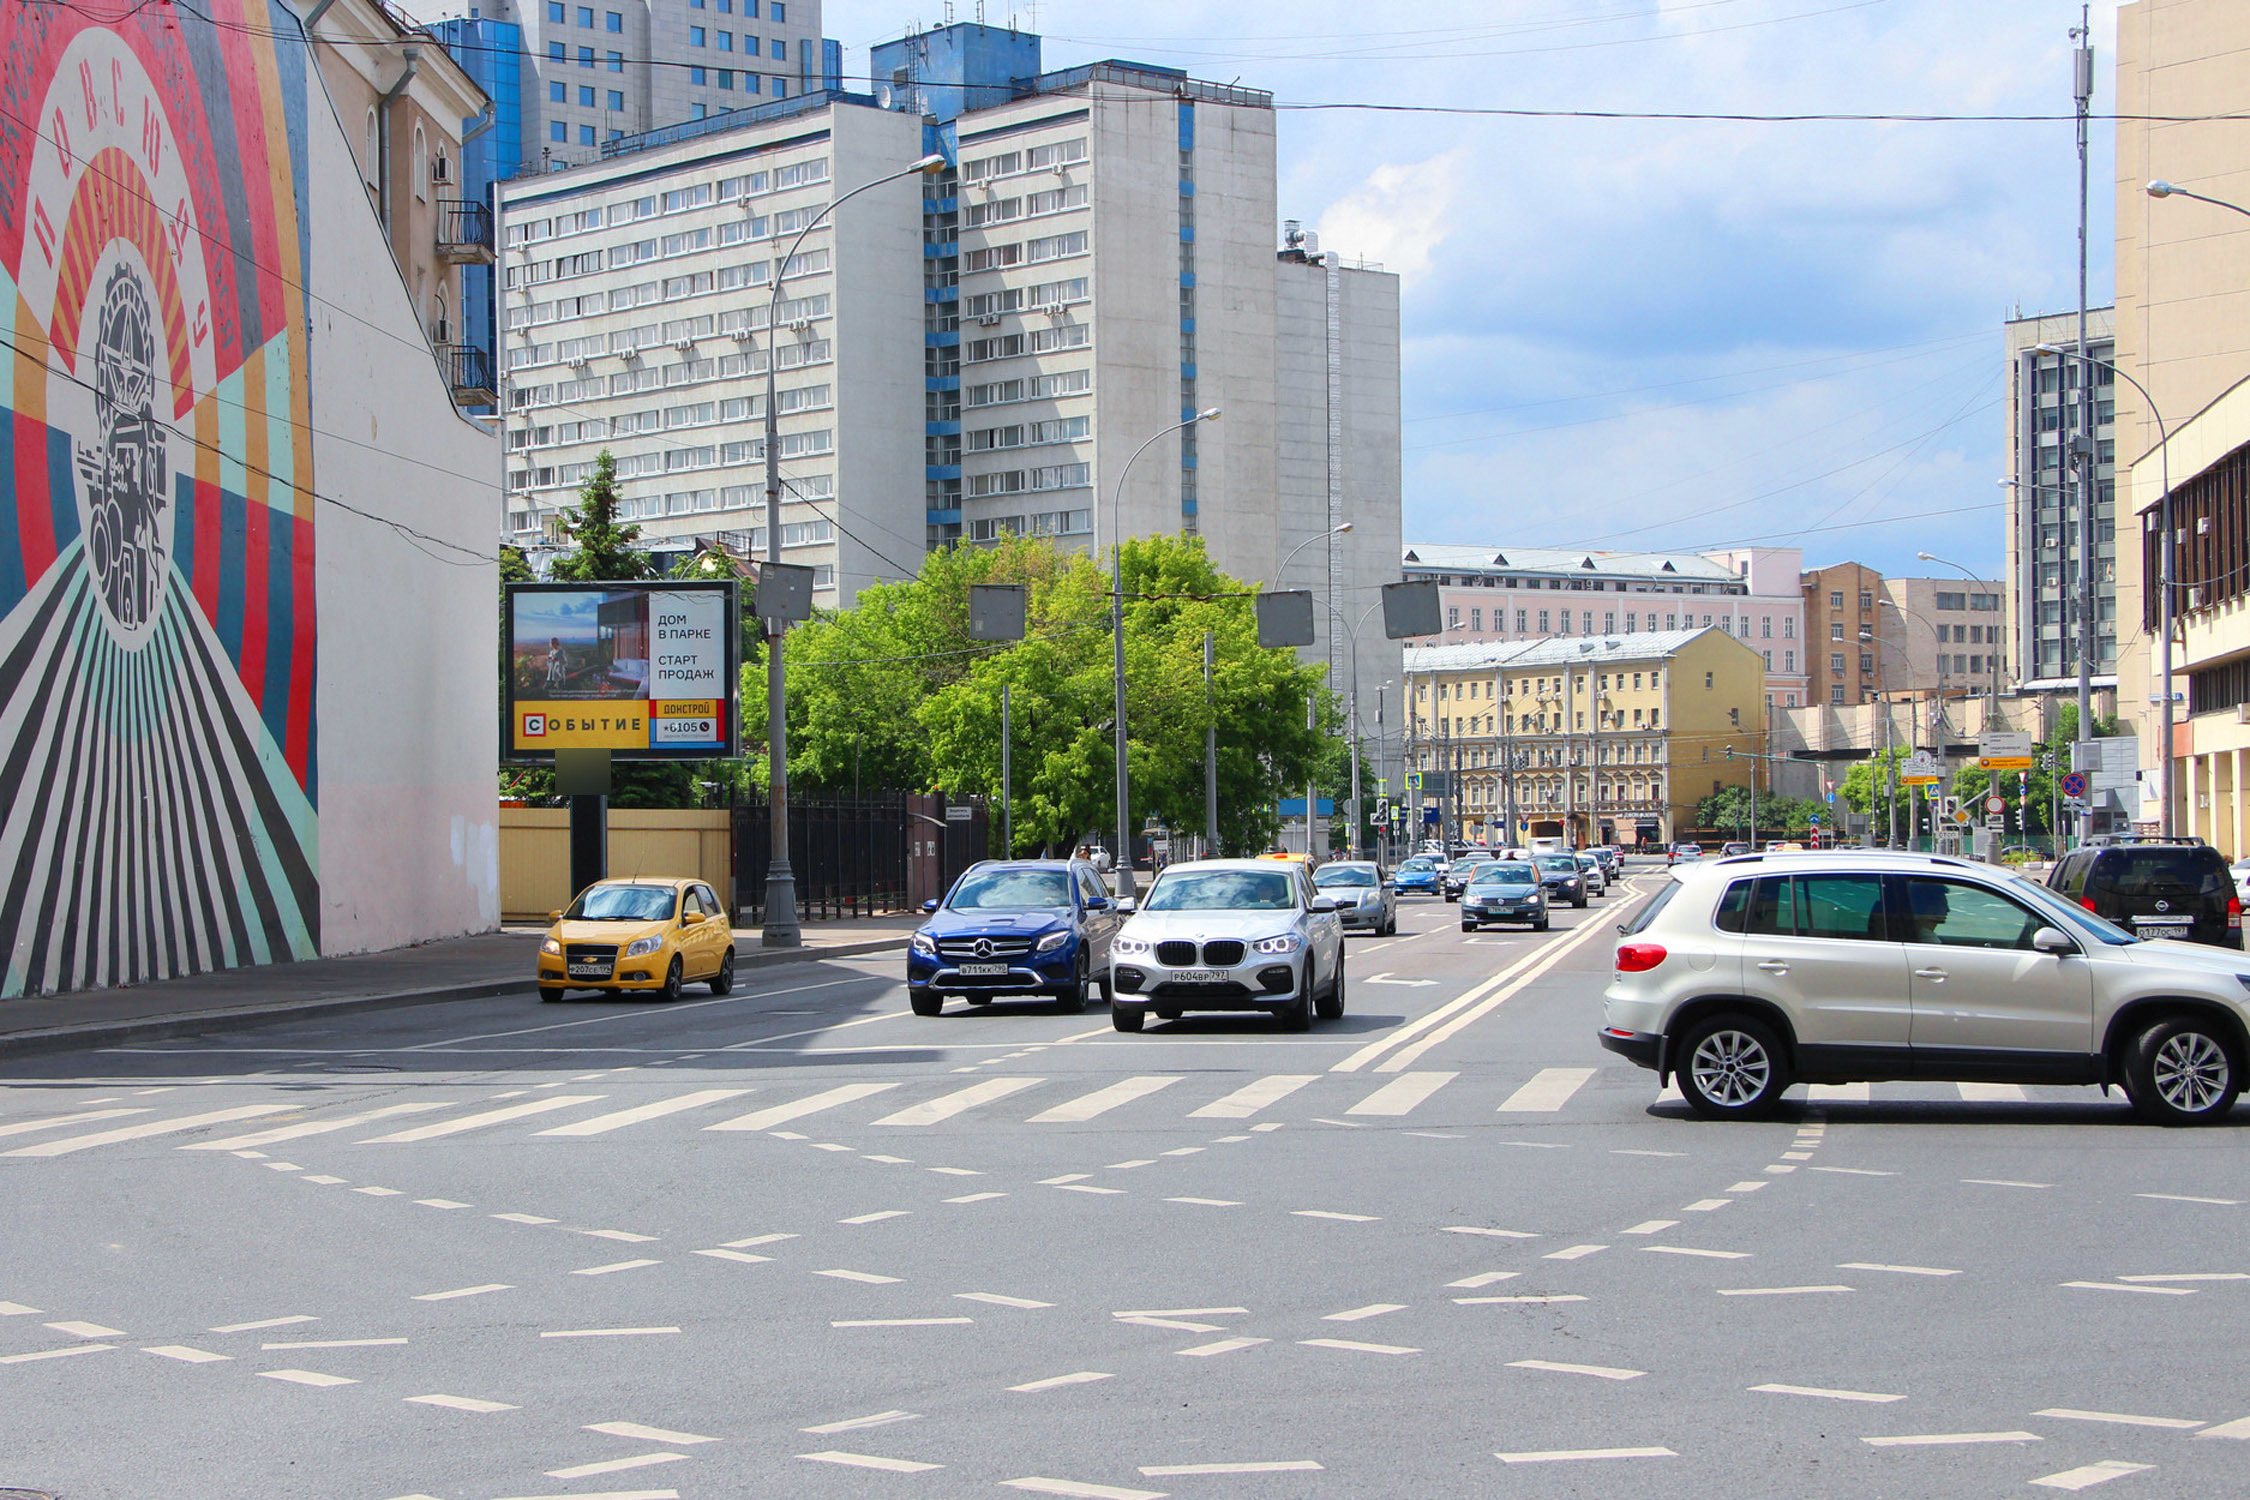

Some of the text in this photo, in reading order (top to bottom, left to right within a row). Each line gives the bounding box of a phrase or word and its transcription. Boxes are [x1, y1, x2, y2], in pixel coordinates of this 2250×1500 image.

[658, 614, 687, 627] ДОМ
[658, 628, 712, 639] В ПАРКЕ
[658, 655, 698, 666] СТАРТ
[658, 669, 715, 681] ПРОДАЖ
[664, 702, 710, 714] ДОНСТРОЙ
[528, 718, 641, 731] СОБЫТИЕ
